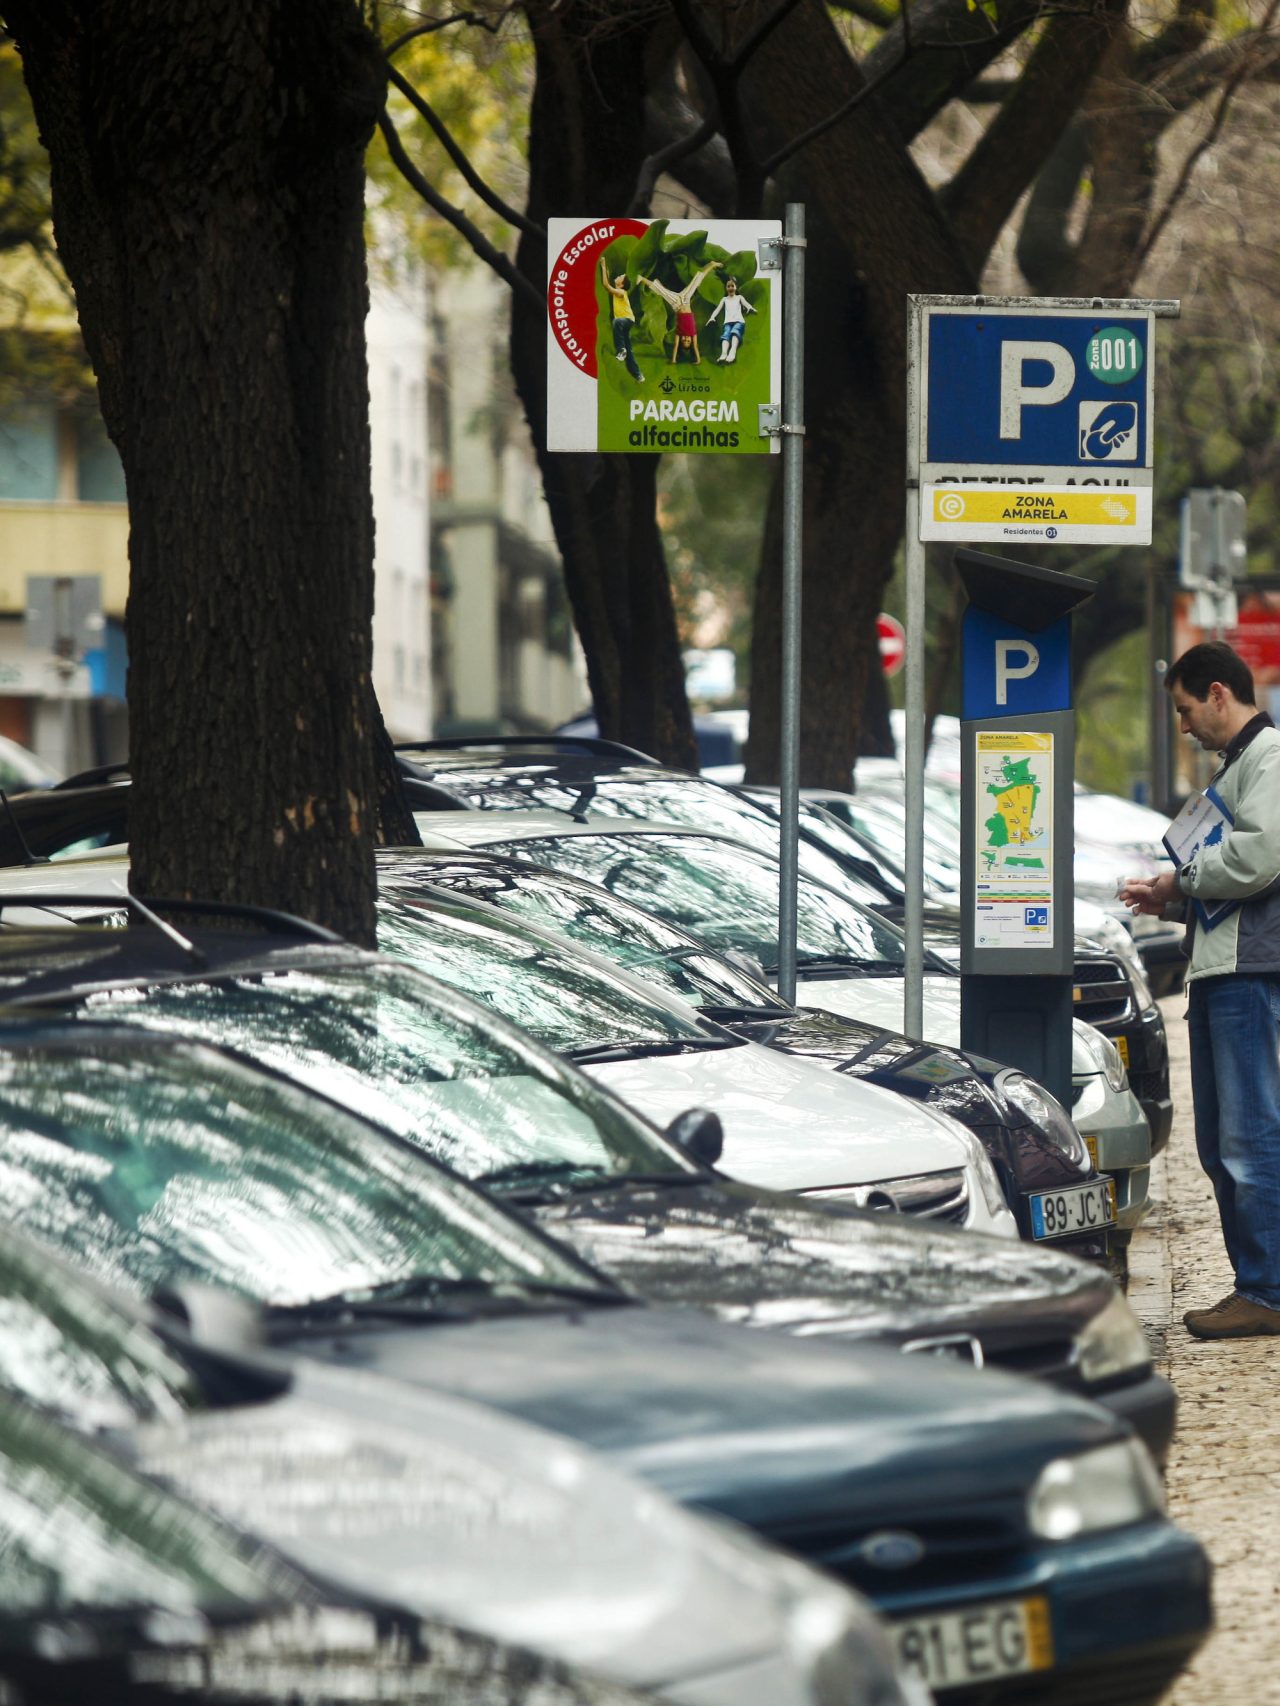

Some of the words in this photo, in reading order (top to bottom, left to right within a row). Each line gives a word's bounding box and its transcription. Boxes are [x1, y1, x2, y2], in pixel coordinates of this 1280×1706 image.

[562, 224, 615, 266] Escolar
[551, 270, 588, 367] Transporte
[1101, 338, 1137, 370] 001
[1000, 340, 1076, 440] P
[629, 399, 740, 422] PARAGEM
[629, 425, 740, 447] alfacinhas
[1015, 496, 1055, 507] ZONA
[1002, 508, 1068, 520] AMARELA
[1003, 527, 1044, 536] Residentes
[995, 639, 1040, 705] P
[1026, 909, 1037, 924] P
